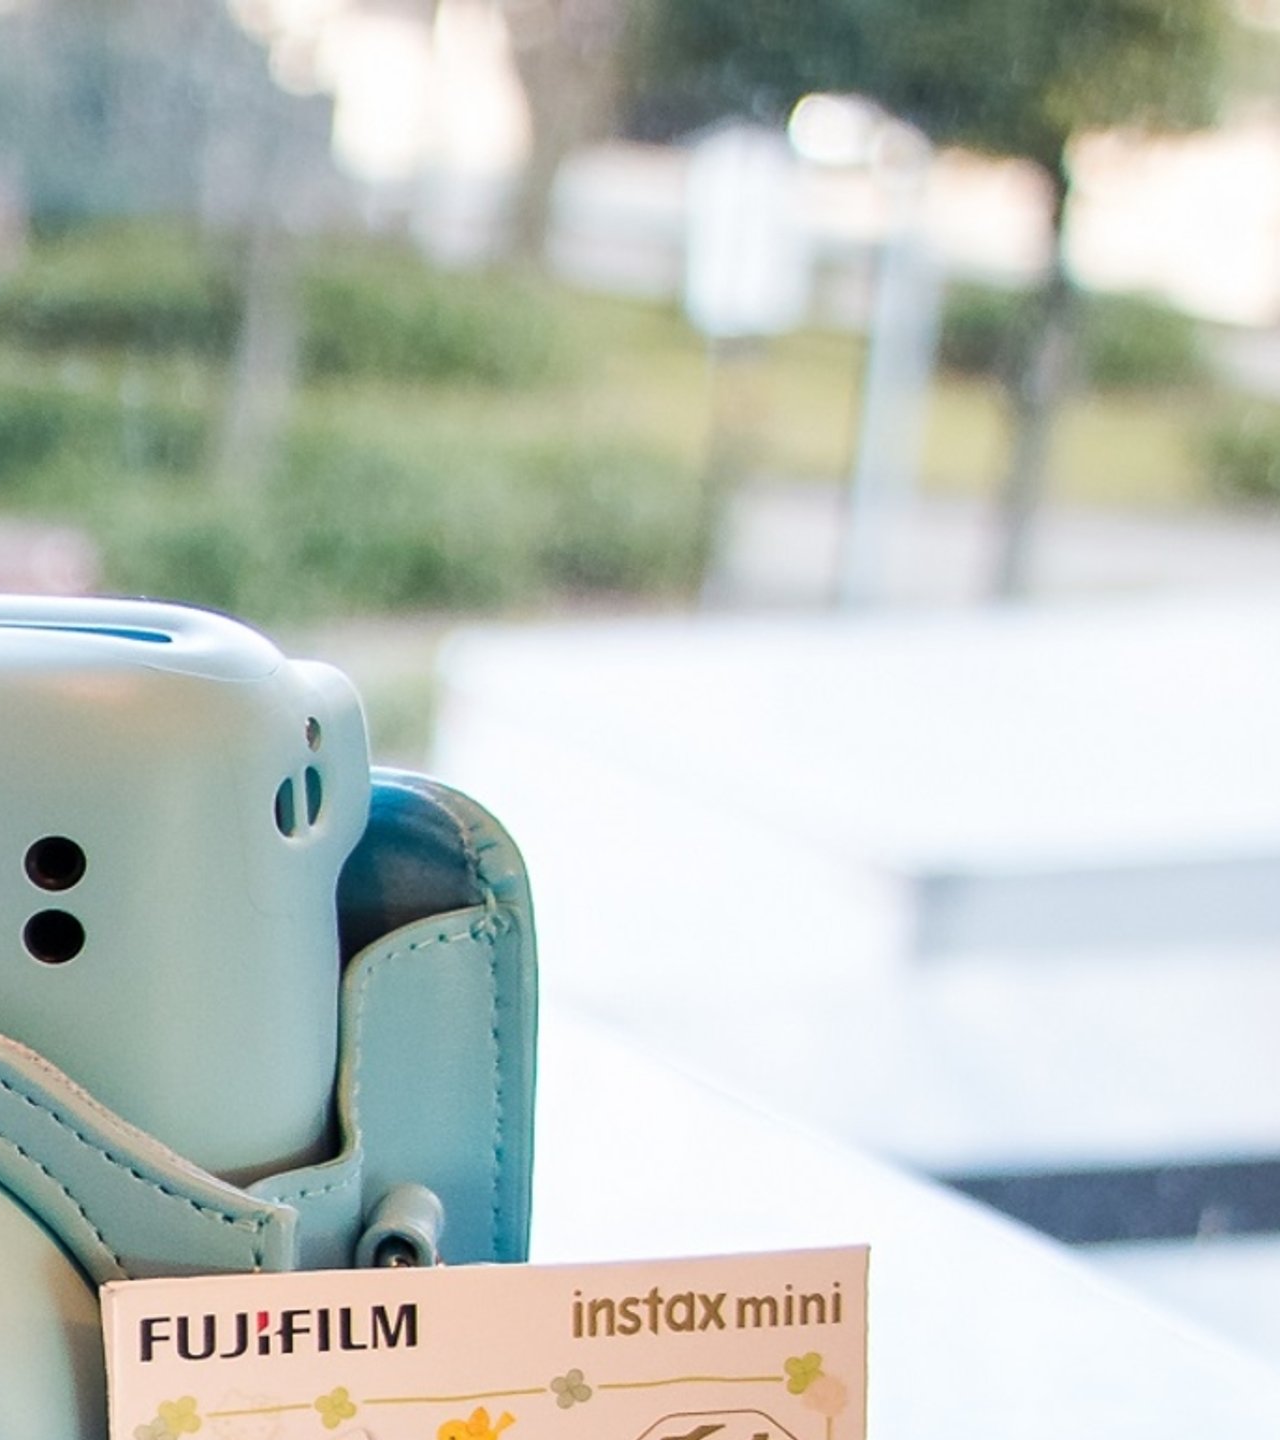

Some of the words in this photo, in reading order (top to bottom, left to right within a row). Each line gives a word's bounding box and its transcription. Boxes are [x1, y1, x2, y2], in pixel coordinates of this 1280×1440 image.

[139, 1302, 418, 1363] FUJIFILM
[572, 1288, 726, 1338] instax
[737, 1283, 842, 1328] mini
